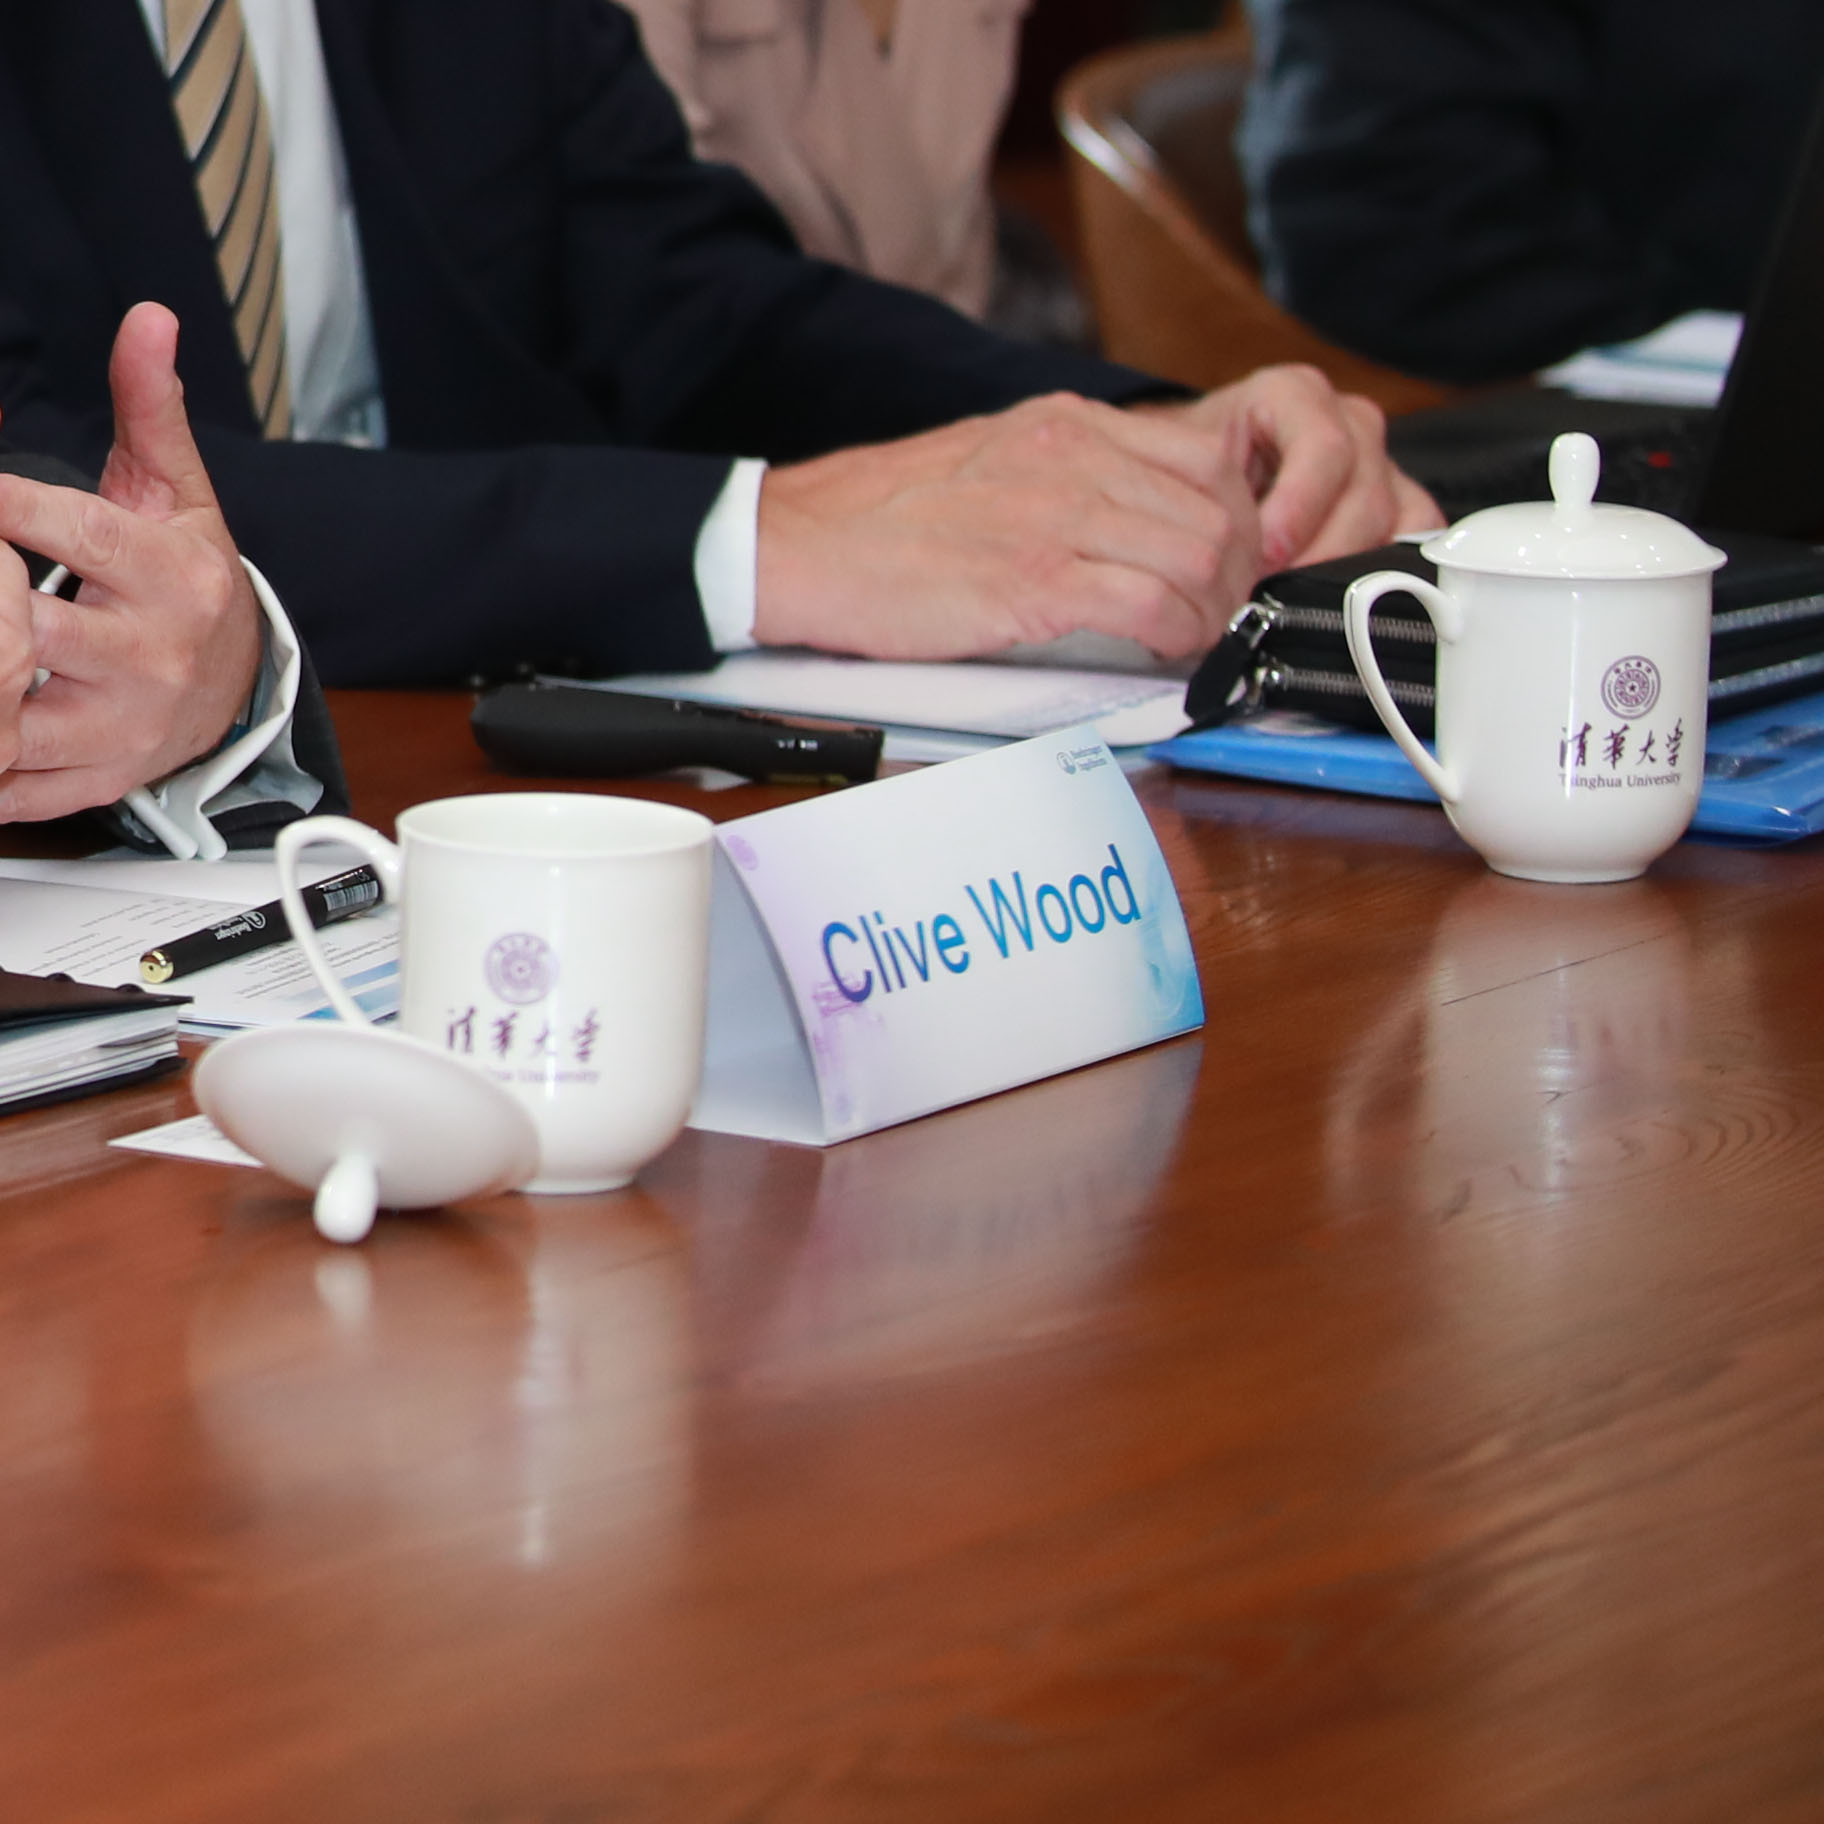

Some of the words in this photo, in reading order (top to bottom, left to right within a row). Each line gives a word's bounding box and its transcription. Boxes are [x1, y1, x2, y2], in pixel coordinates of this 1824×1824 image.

[1558, 773, 1622, 790] Tinghua
[821, 909, 971, 1004] Clive
[964, 843, 1142, 960] Wood
